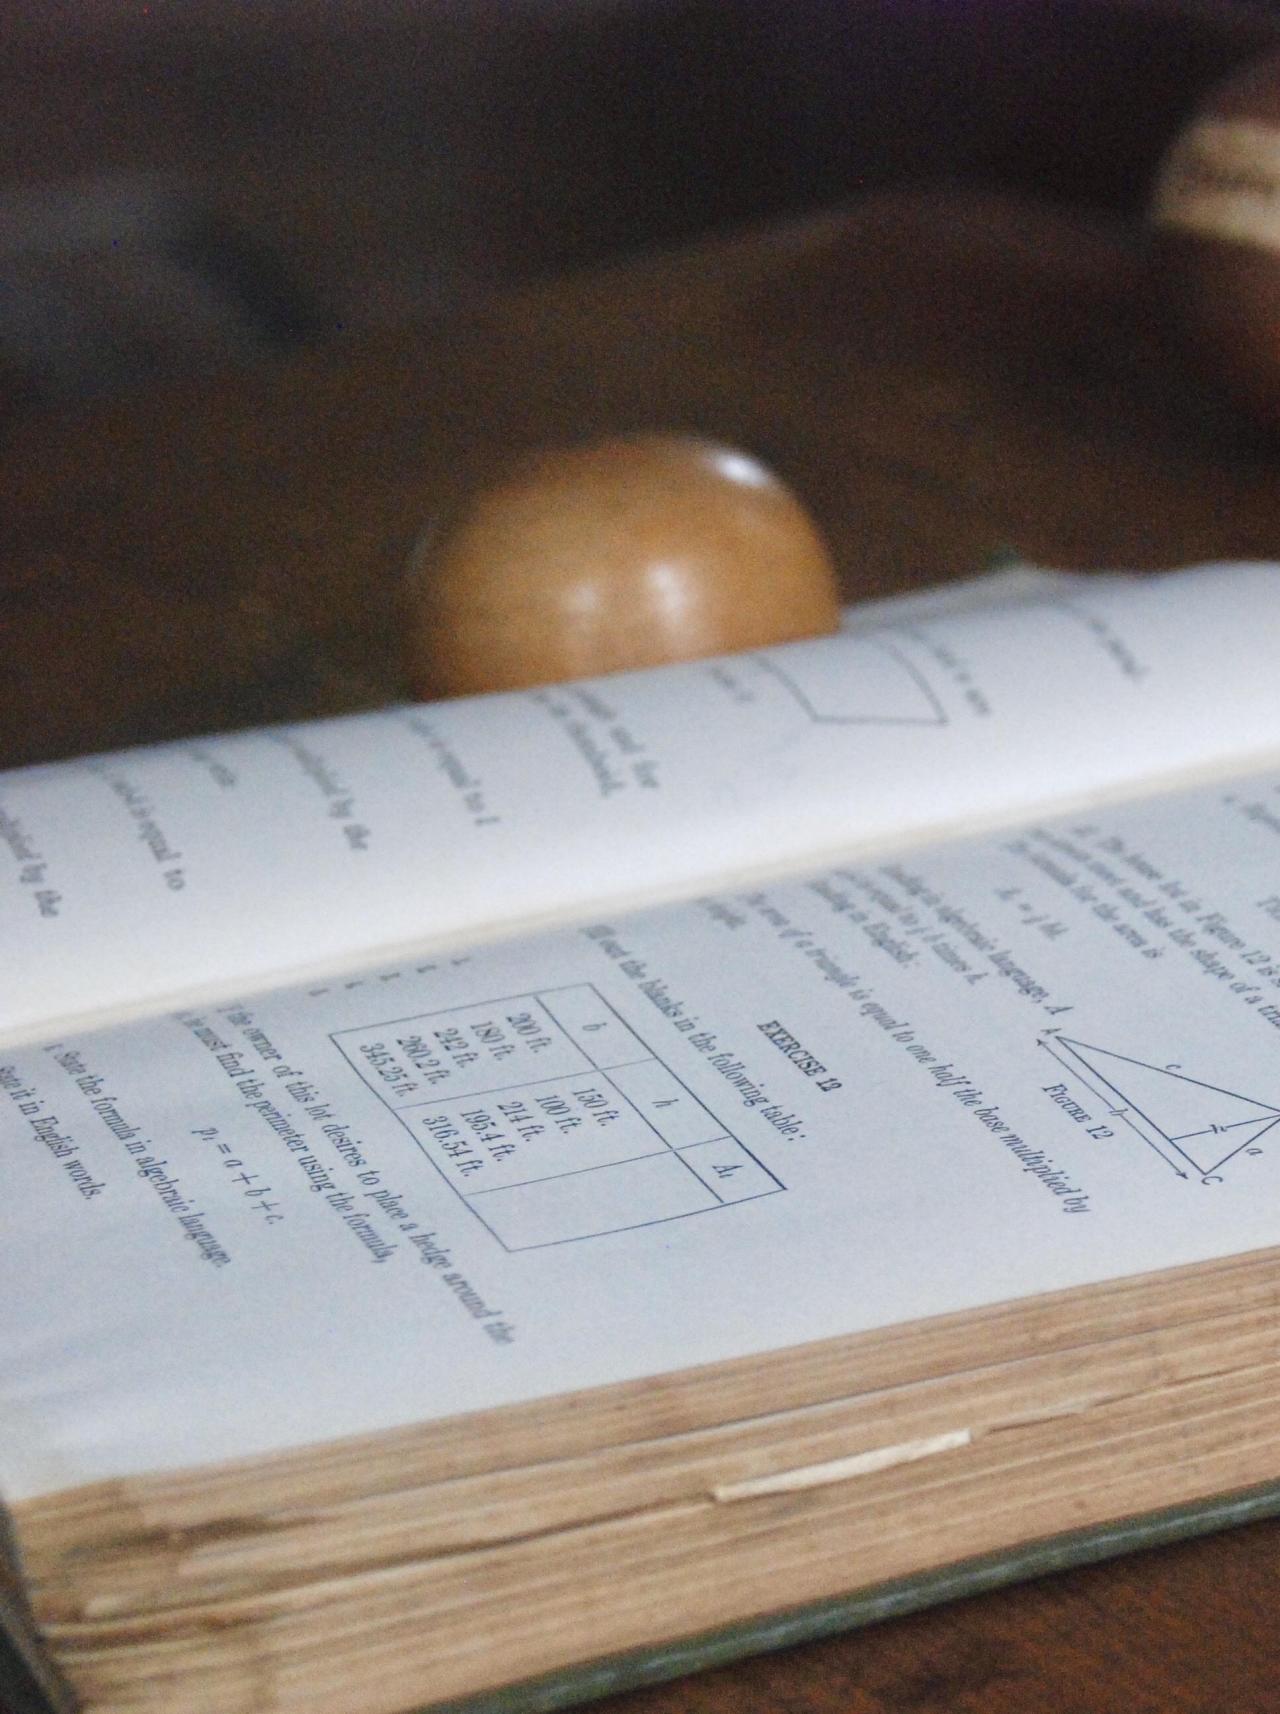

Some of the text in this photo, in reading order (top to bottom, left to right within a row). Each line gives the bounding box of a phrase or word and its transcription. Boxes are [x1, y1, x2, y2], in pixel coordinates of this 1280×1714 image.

[1240, 949, 1272, 965] 12
[1229, 981, 1262, 994] of
[1244, 994, 1264, 1005] a
[1043, 1005, 1075, 1016] A
[506, 1012, 553, 1053] 200 ft.
[582, 1022, 608, 1032] b
[1040, 1026, 1063, 1036] A
[242, 1027, 283, 1061] owner
[433, 1028, 479, 1068] 242 ft.
[489, 1043, 516, 1061] ft.
[216, 1051, 254, 1077] find
[359, 1042, 409, 1082] 345.25
[638, 979, 684, 1018] blanks
[674, 1016, 700, 1032] in
[688, 1031, 718, 1054] the
[707, 1052, 770, 1108] following
[760, 1105, 807, 1142] table:
[756, 1019, 844, 1092] EXERCISE 12
[273, 1065, 304, 1078] of
[1165, 1063, 1183, 1071] c
[10, 1088, 37, 1100] it
[76, 1075, 105, 1096] the
[236, 1079, 264, 1099] the
[285, 1081, 319, 1104] this
[19, 1100, 45, 1115] in
[305, 1103, 336, 1121] lot
[535, 1094, 583, 1134] 100 ft.
[571, 1088, 620, 1127] 150 ft.
[651, 1098, 680, 1109] h
[859, 1001, 911, 1031] equal
[892, 1030, 916, 1043] to
[905, 1044, 937, 1064] one
[927, 1063, 973, 1088] half
[952, 1088, 984, 1108] the
[973, 1106, 1011, 1134] base
[1000, 1133, 1083, 1196] multiplied
[1062, 1195, 1091, 1214] by
[91, 1097, 141, 1141] formula
[245, 1099, 310, 1152] perimeter
[497, 1101, 545, 1142] 214 ft.
[30, 1116, 80, 1159] English
[460, 1108, 516, 1162] 195.4 ft.
[1086, 1124, 1116, 1141] 12
[124, 1140, 152, 1155] in
[217, 1144, 231, 1154] =
[322, 1123, 367, 1168] desires
[422, 1115, 484, 1177] 316.54 ft.
[1244, 1147, 1265, 1156] a
[223, 1160, 242, 1168] a
[298, 1156, 336, 1193] using
[63, 1160, 106, 1200] words.
[136, 1157, 195, 1213] algebraic
[232, 1172, 259, 1185] +
[357, 1170, 380, 1185] to
[1200, 1174, 1225, 1186] C
[244, 1188, 271, 1197] b
[326, 1191, 355, 1212] the
[251, 1201, 279, 1211] +
[364, 1190, 409, 1220] place
[265, 1213, 284, 1225] c.
[399, 1223, 419, 1231] a
[178, 1212, 231, 1267] language.
[343, 1213, 398, 1263] formula,
[408, 1232, 452, 1269] hedge
[443, 1273, 503, 1319] around
